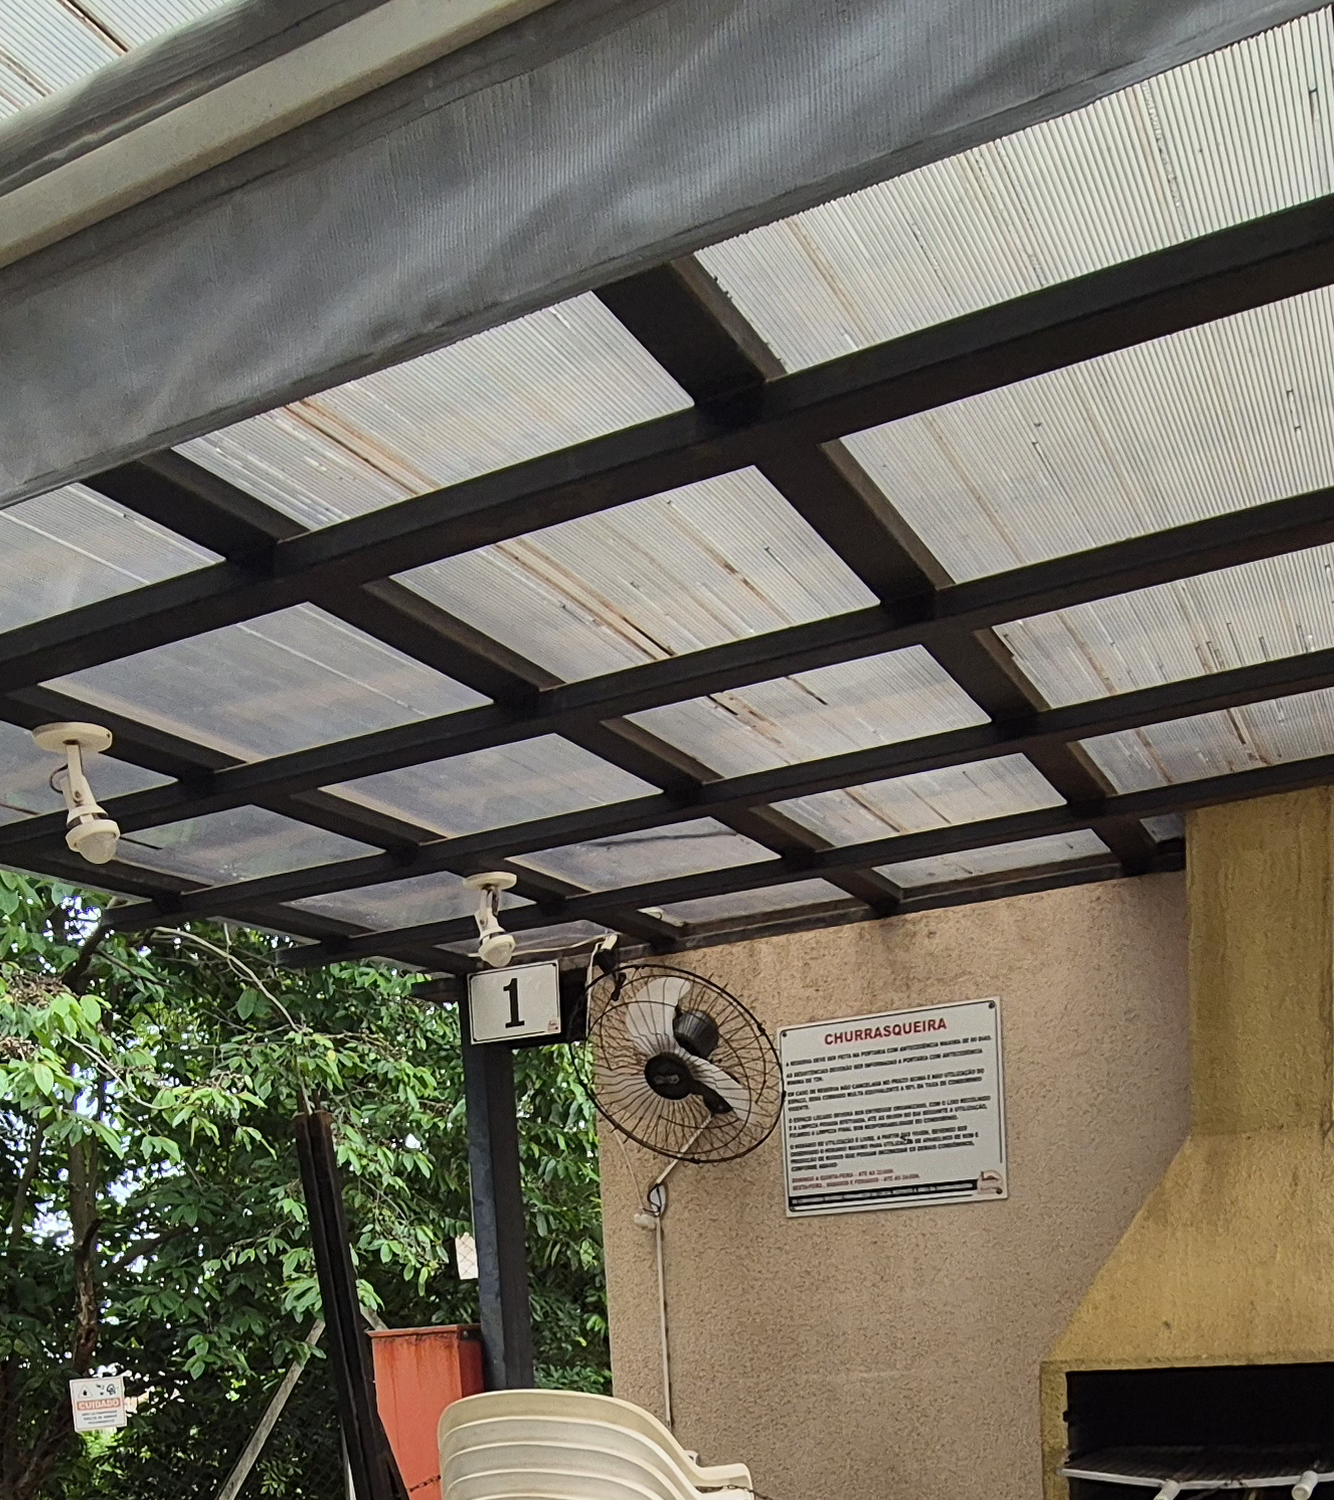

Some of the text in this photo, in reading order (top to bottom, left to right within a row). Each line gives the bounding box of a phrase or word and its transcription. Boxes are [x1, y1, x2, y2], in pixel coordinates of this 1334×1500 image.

[503, 978, 525, 1029] 1
[825, 1018, 947, 1045] CHURRASQUEIRA
[78, 1399, 119, 1409] CUIDADO
